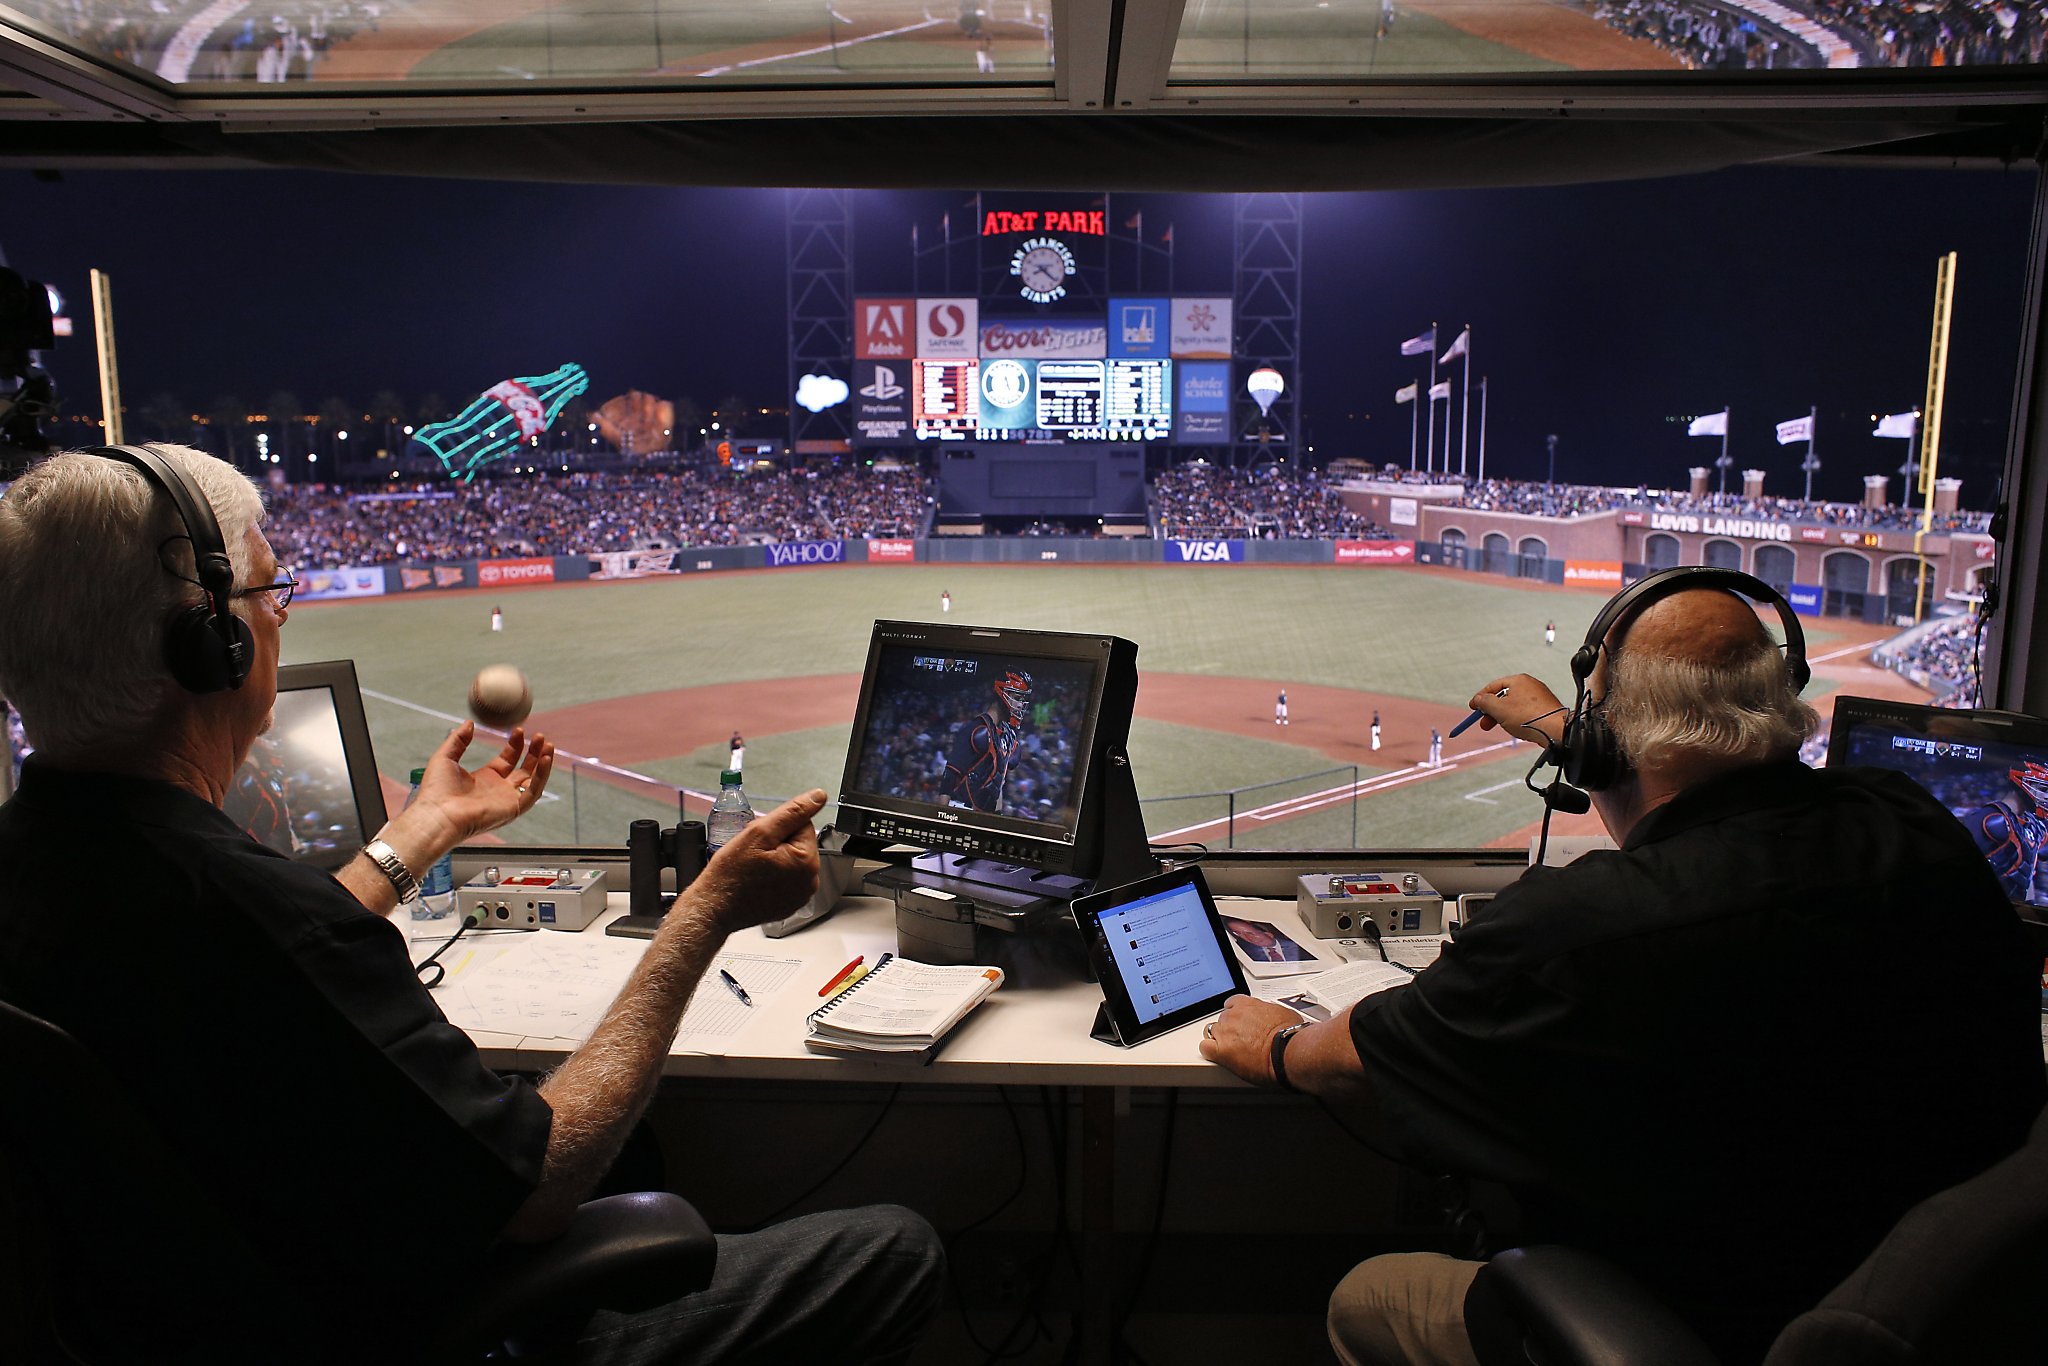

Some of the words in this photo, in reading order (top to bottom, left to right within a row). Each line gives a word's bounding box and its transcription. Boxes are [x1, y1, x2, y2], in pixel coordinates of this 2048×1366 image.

[982, 211, 1038, 236] AT&T
[1044, 211, 1104, 236] PARK
[1010, 249, 1026, 275] SAN
[1022, 237, 1076, 275] FRANCISCO
[1020, 286, 1066, 303] GIANTS
[982, 324, 1054, 352] Coors
[867, 342, 904, 356] Adobe
[862, 404, 902, 415] PlayStation
[857, 420, 907, 430] GREATNESS
[865, 430, 900, 439] AWAITS
[1703, 517, 1792, 542] LANDING
[769, 542, 843, 566] YAHOO!
[1176, 541, 1230, 561] VISA
[501, 564, 553, 580] TOYOTA
